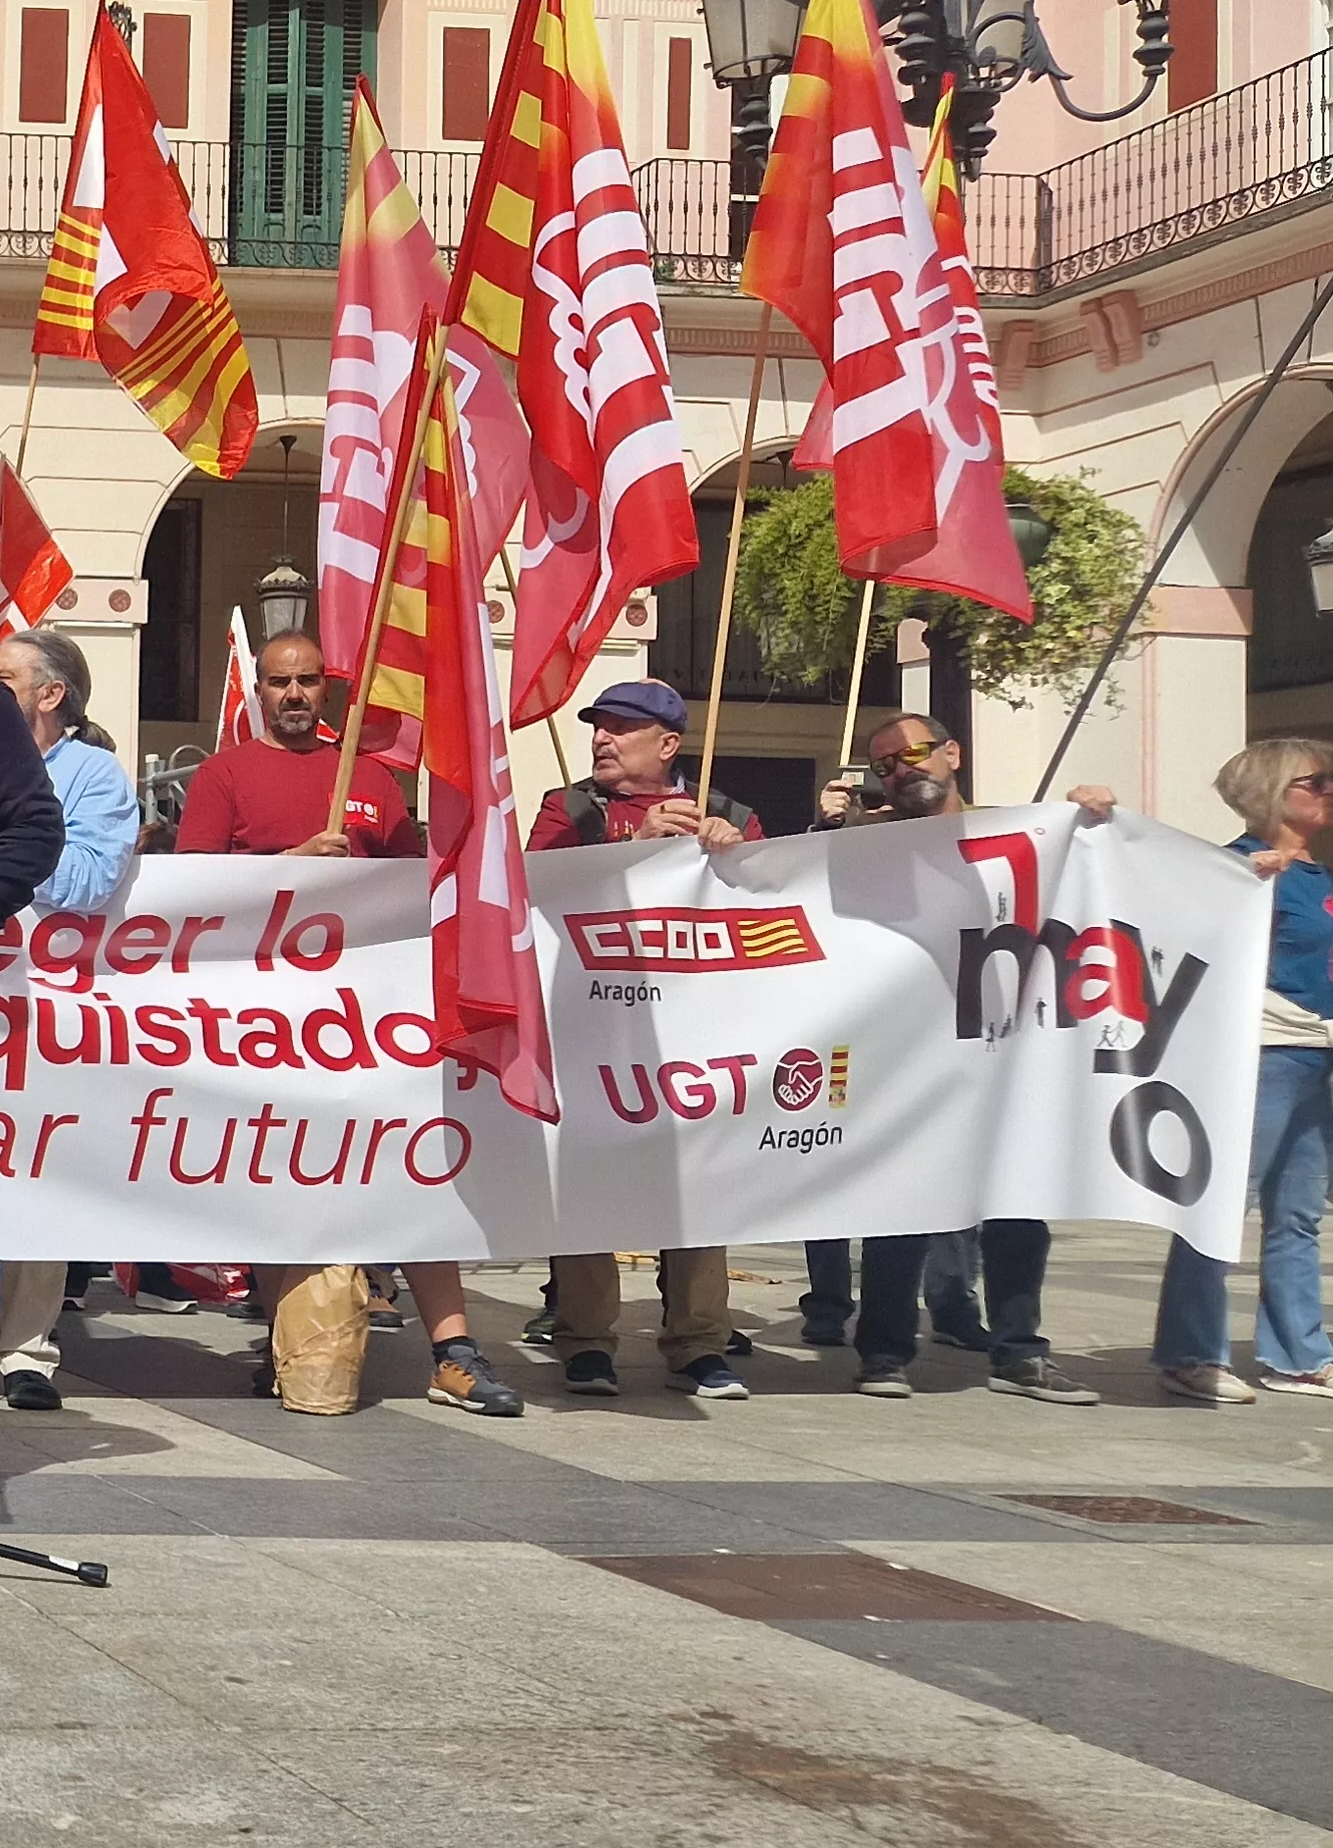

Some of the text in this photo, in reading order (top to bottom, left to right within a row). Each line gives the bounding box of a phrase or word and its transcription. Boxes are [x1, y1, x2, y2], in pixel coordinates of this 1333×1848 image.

[254, 889, 345, 972] lo
[581, 919, 735, 960] CCOO
[589, 979, 662, 1007] Aragón
[597, 1053, 759, 1124] UGT
[127, 1087, 473, 1186] futuro
[758, 1121, 844, 1154] Aragón
